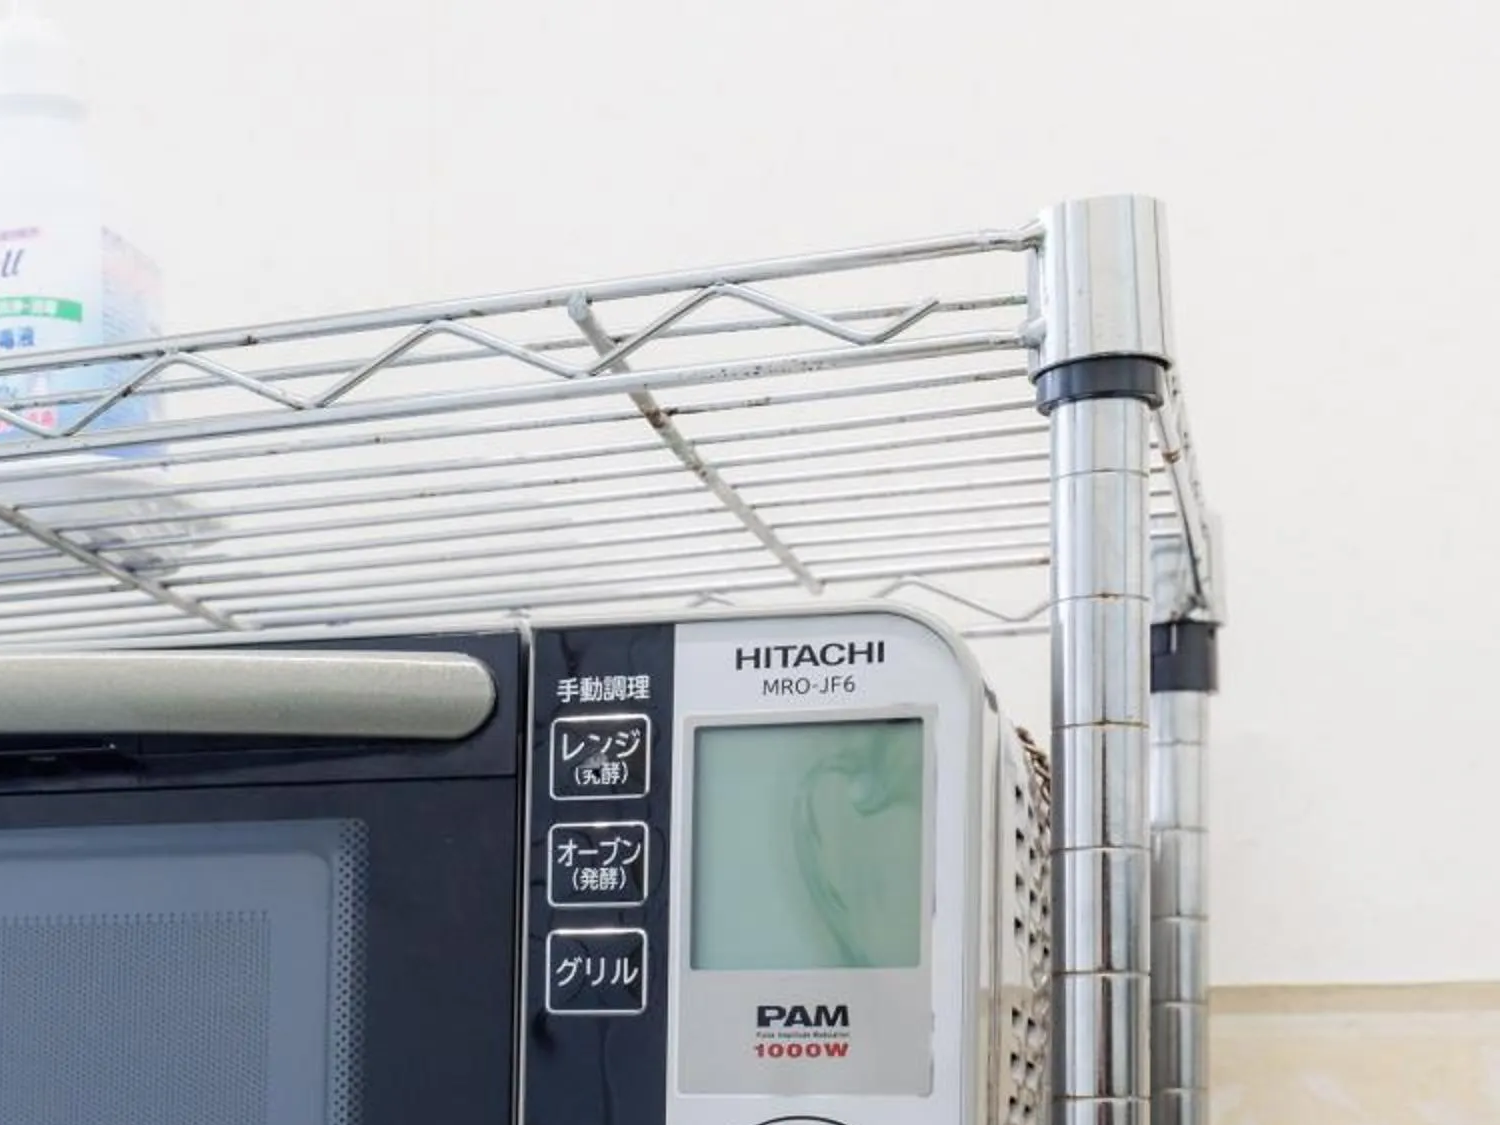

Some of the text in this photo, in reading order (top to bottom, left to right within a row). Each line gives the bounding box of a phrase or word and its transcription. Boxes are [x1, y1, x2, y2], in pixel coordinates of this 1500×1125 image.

[735, 641, 885, 670] HITACHI
[557, 675, 650, 703] 手動調理
[763, 677, 856, 696] MRO-JF6
[563, 729, 641, 761] レンジ
[557, 836, 641, 867] オーブン
[556, 956, 638, 987] グリル
[756, 1005, 850, 1028] PAM
[753, 1042, 850, 1058] 1000W
